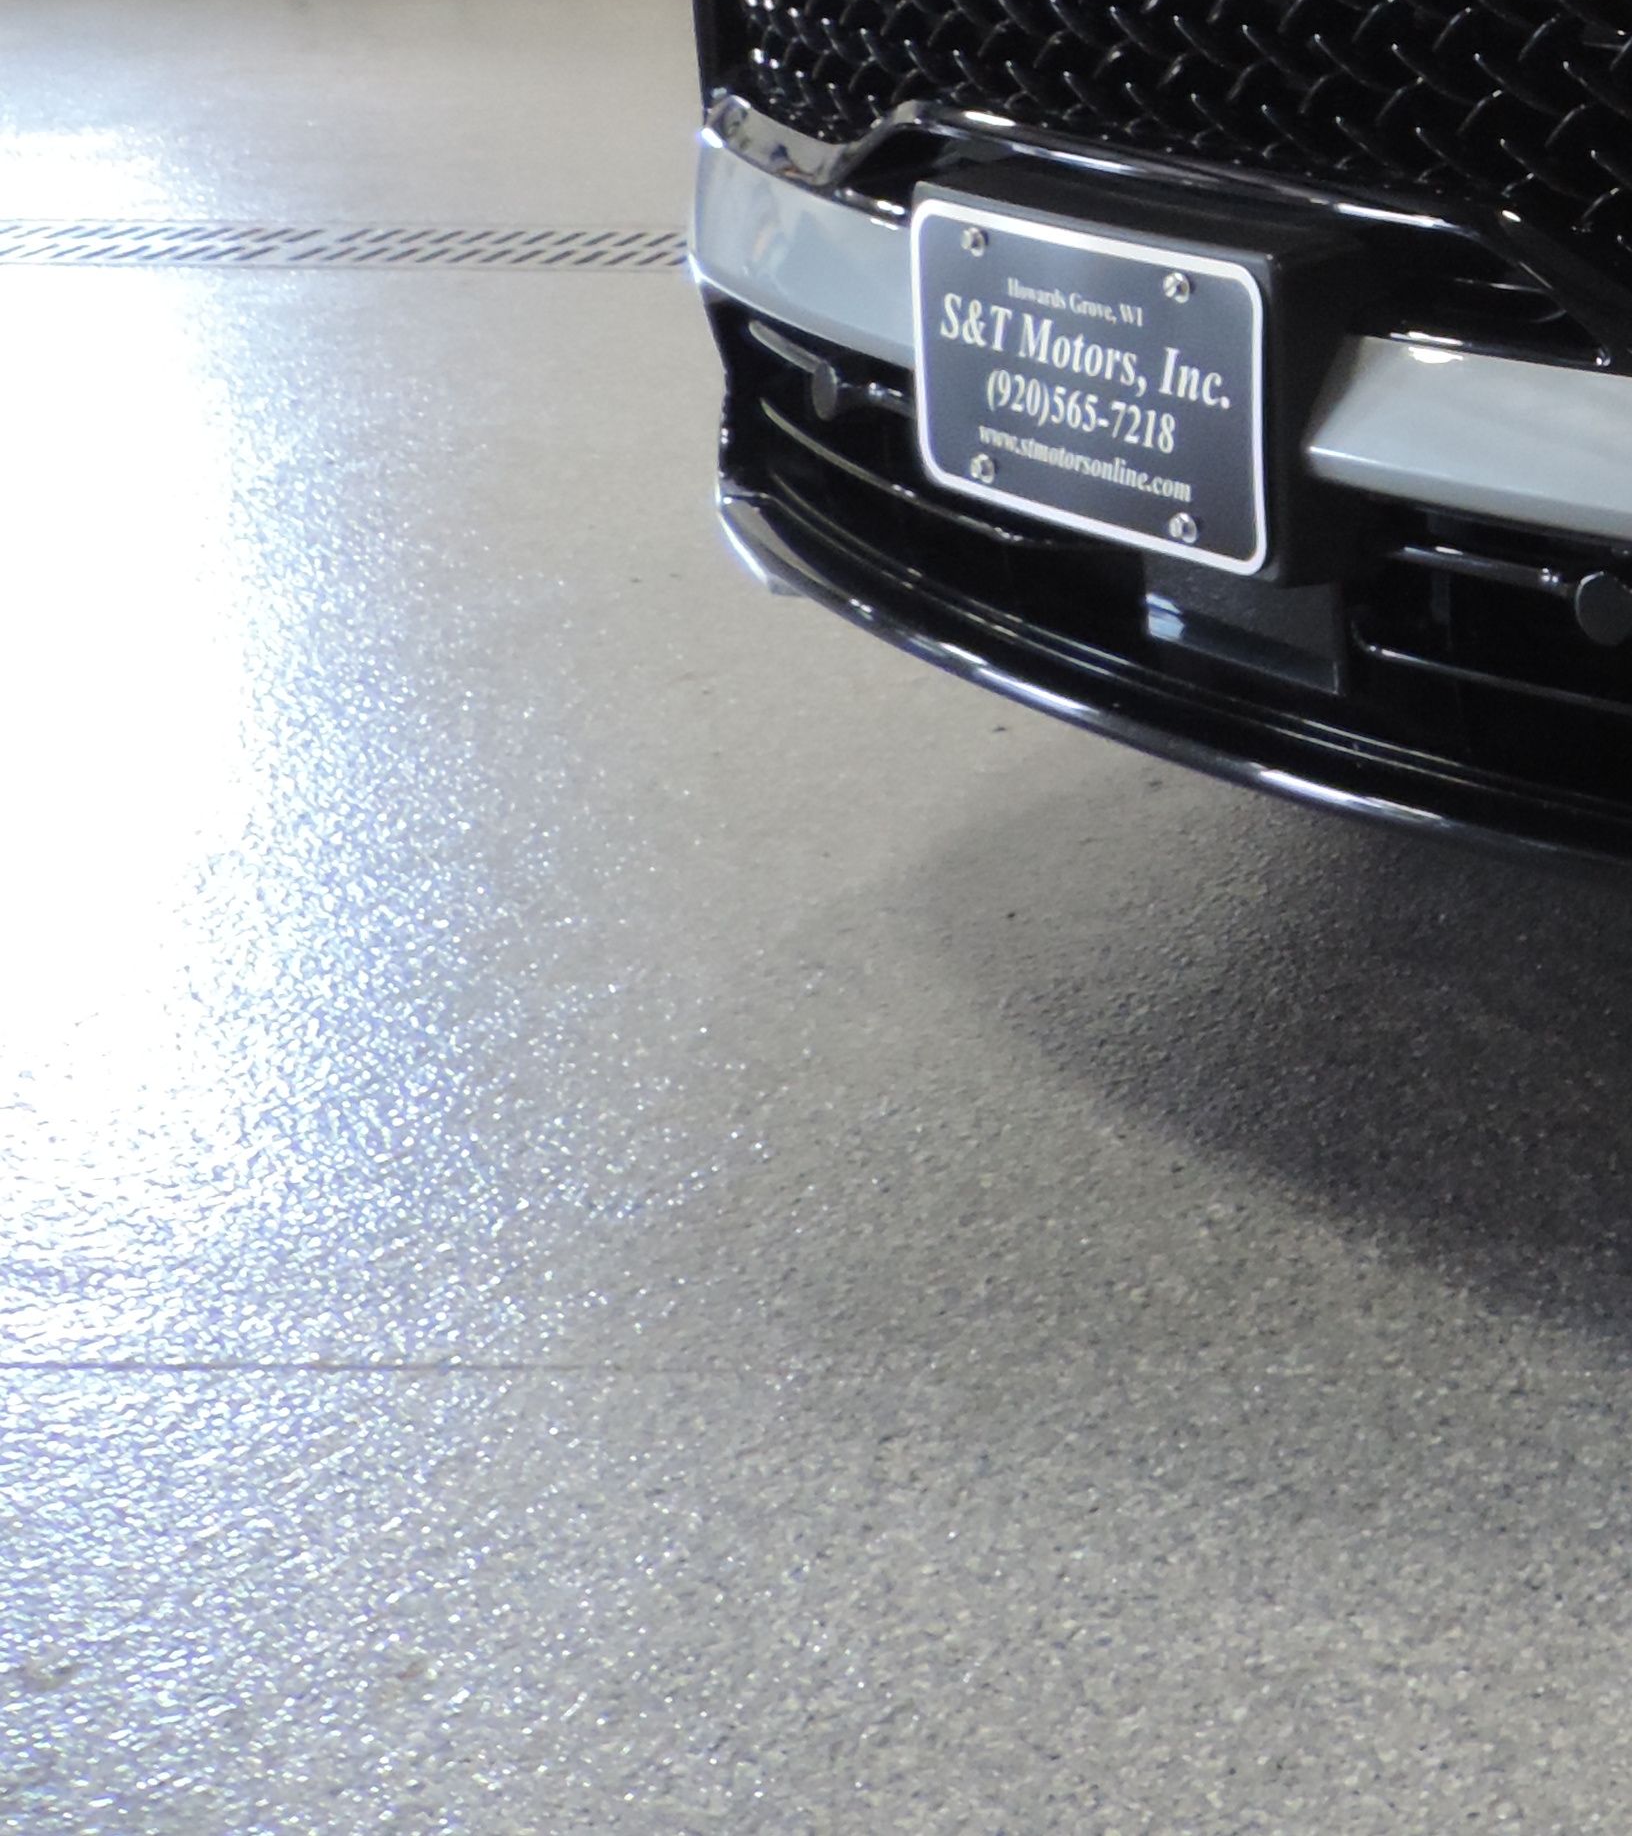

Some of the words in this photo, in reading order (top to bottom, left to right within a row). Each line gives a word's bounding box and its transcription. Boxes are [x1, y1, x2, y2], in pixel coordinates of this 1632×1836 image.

[1007, 277, 1066, 312] Howards
[1069, 291, 1117, 325] Grove,
[1119, 303, 1144, 328] WI
[940, 292, 1013, 353] S&T
[1018, 318, 1148, 399] Motors,
[1158, 347, 1232, 410] Inc.
[986, 369, 1176, 454] (920)565-7218
[978, 424, 1193, 503] www.stmotorsonline.com
